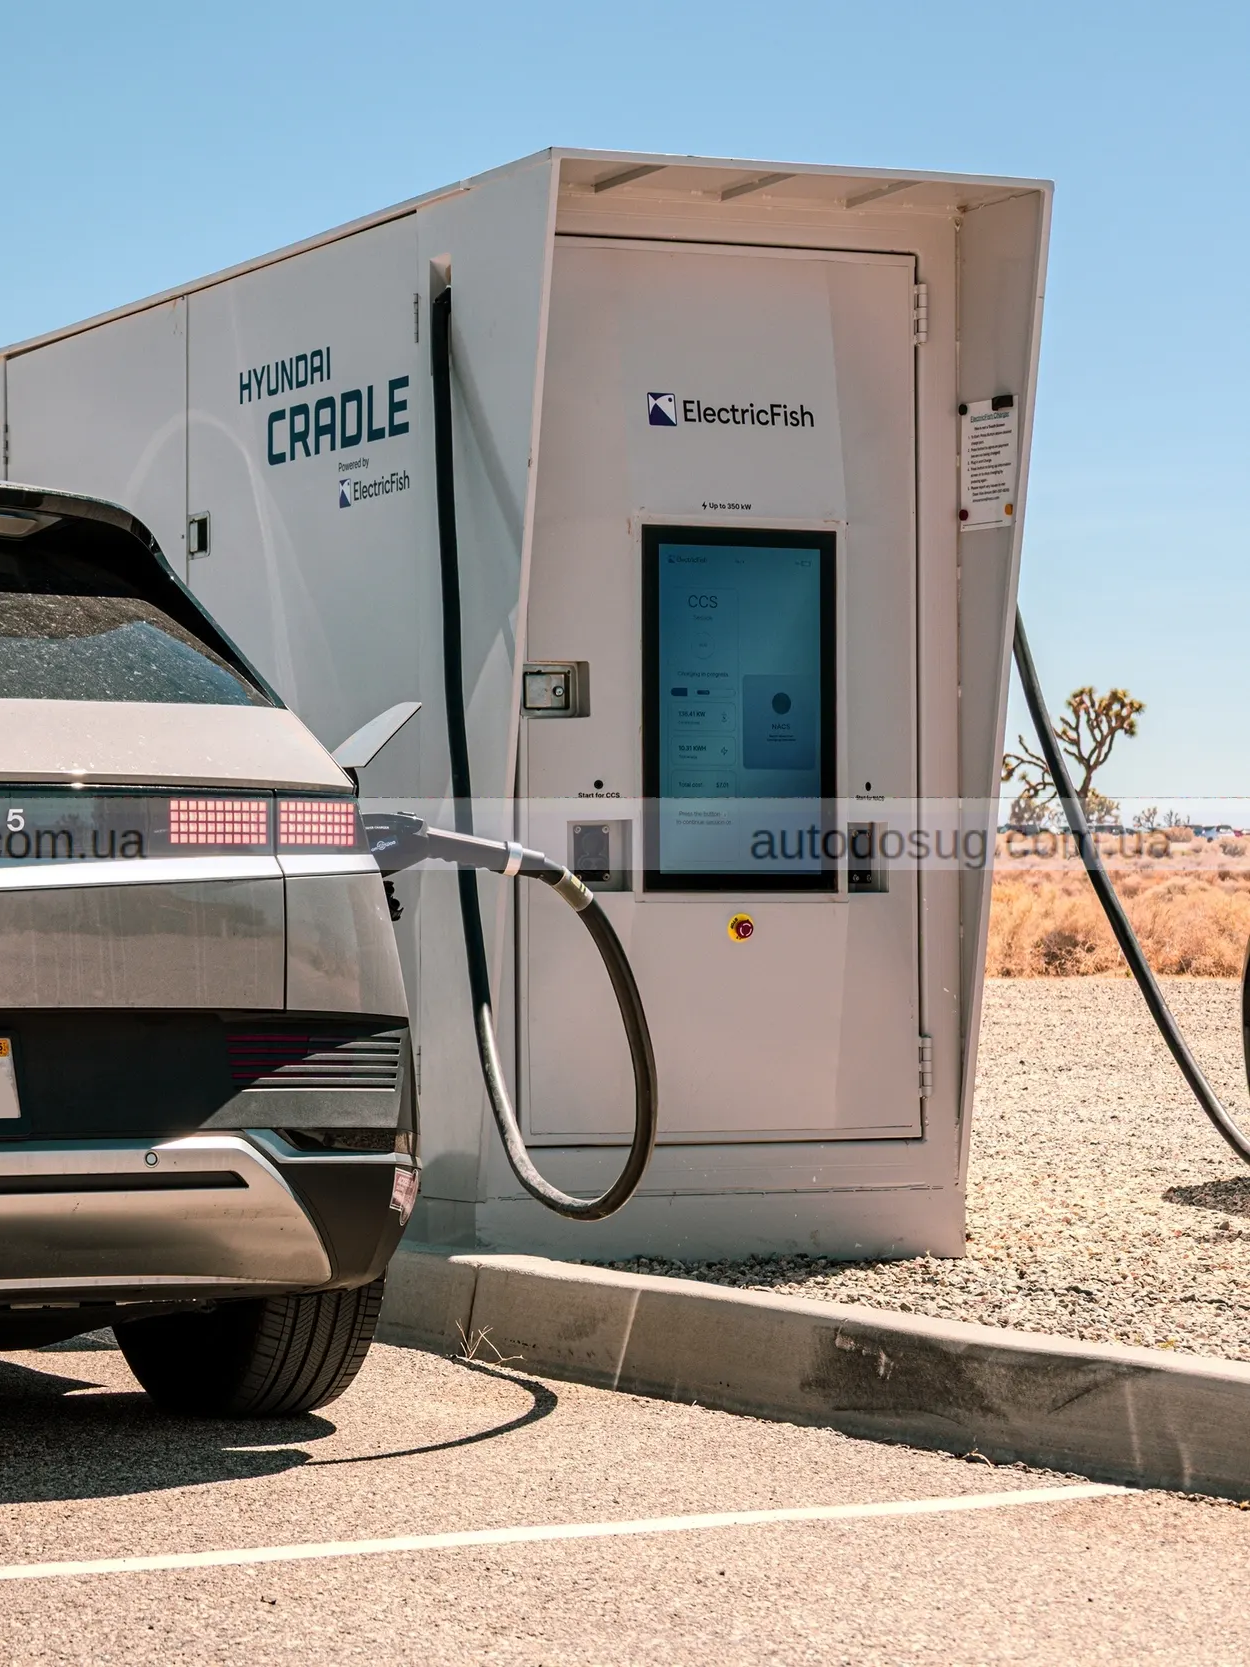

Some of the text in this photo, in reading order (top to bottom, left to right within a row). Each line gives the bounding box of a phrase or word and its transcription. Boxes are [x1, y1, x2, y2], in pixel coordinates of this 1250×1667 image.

[239, 346, 331, 405] HYUNDAI
[267, 375, 410, 466] CRADLE
[682, 399, 815, 427] ElectricFish
[338, 457, 370, 473] Powered by
[353, 470, 410, 502] ElectricFish
[708, 502, 719, 510] Up
[688, 594, 718, 609] CCS
[6, 808, 26, 832] 5
